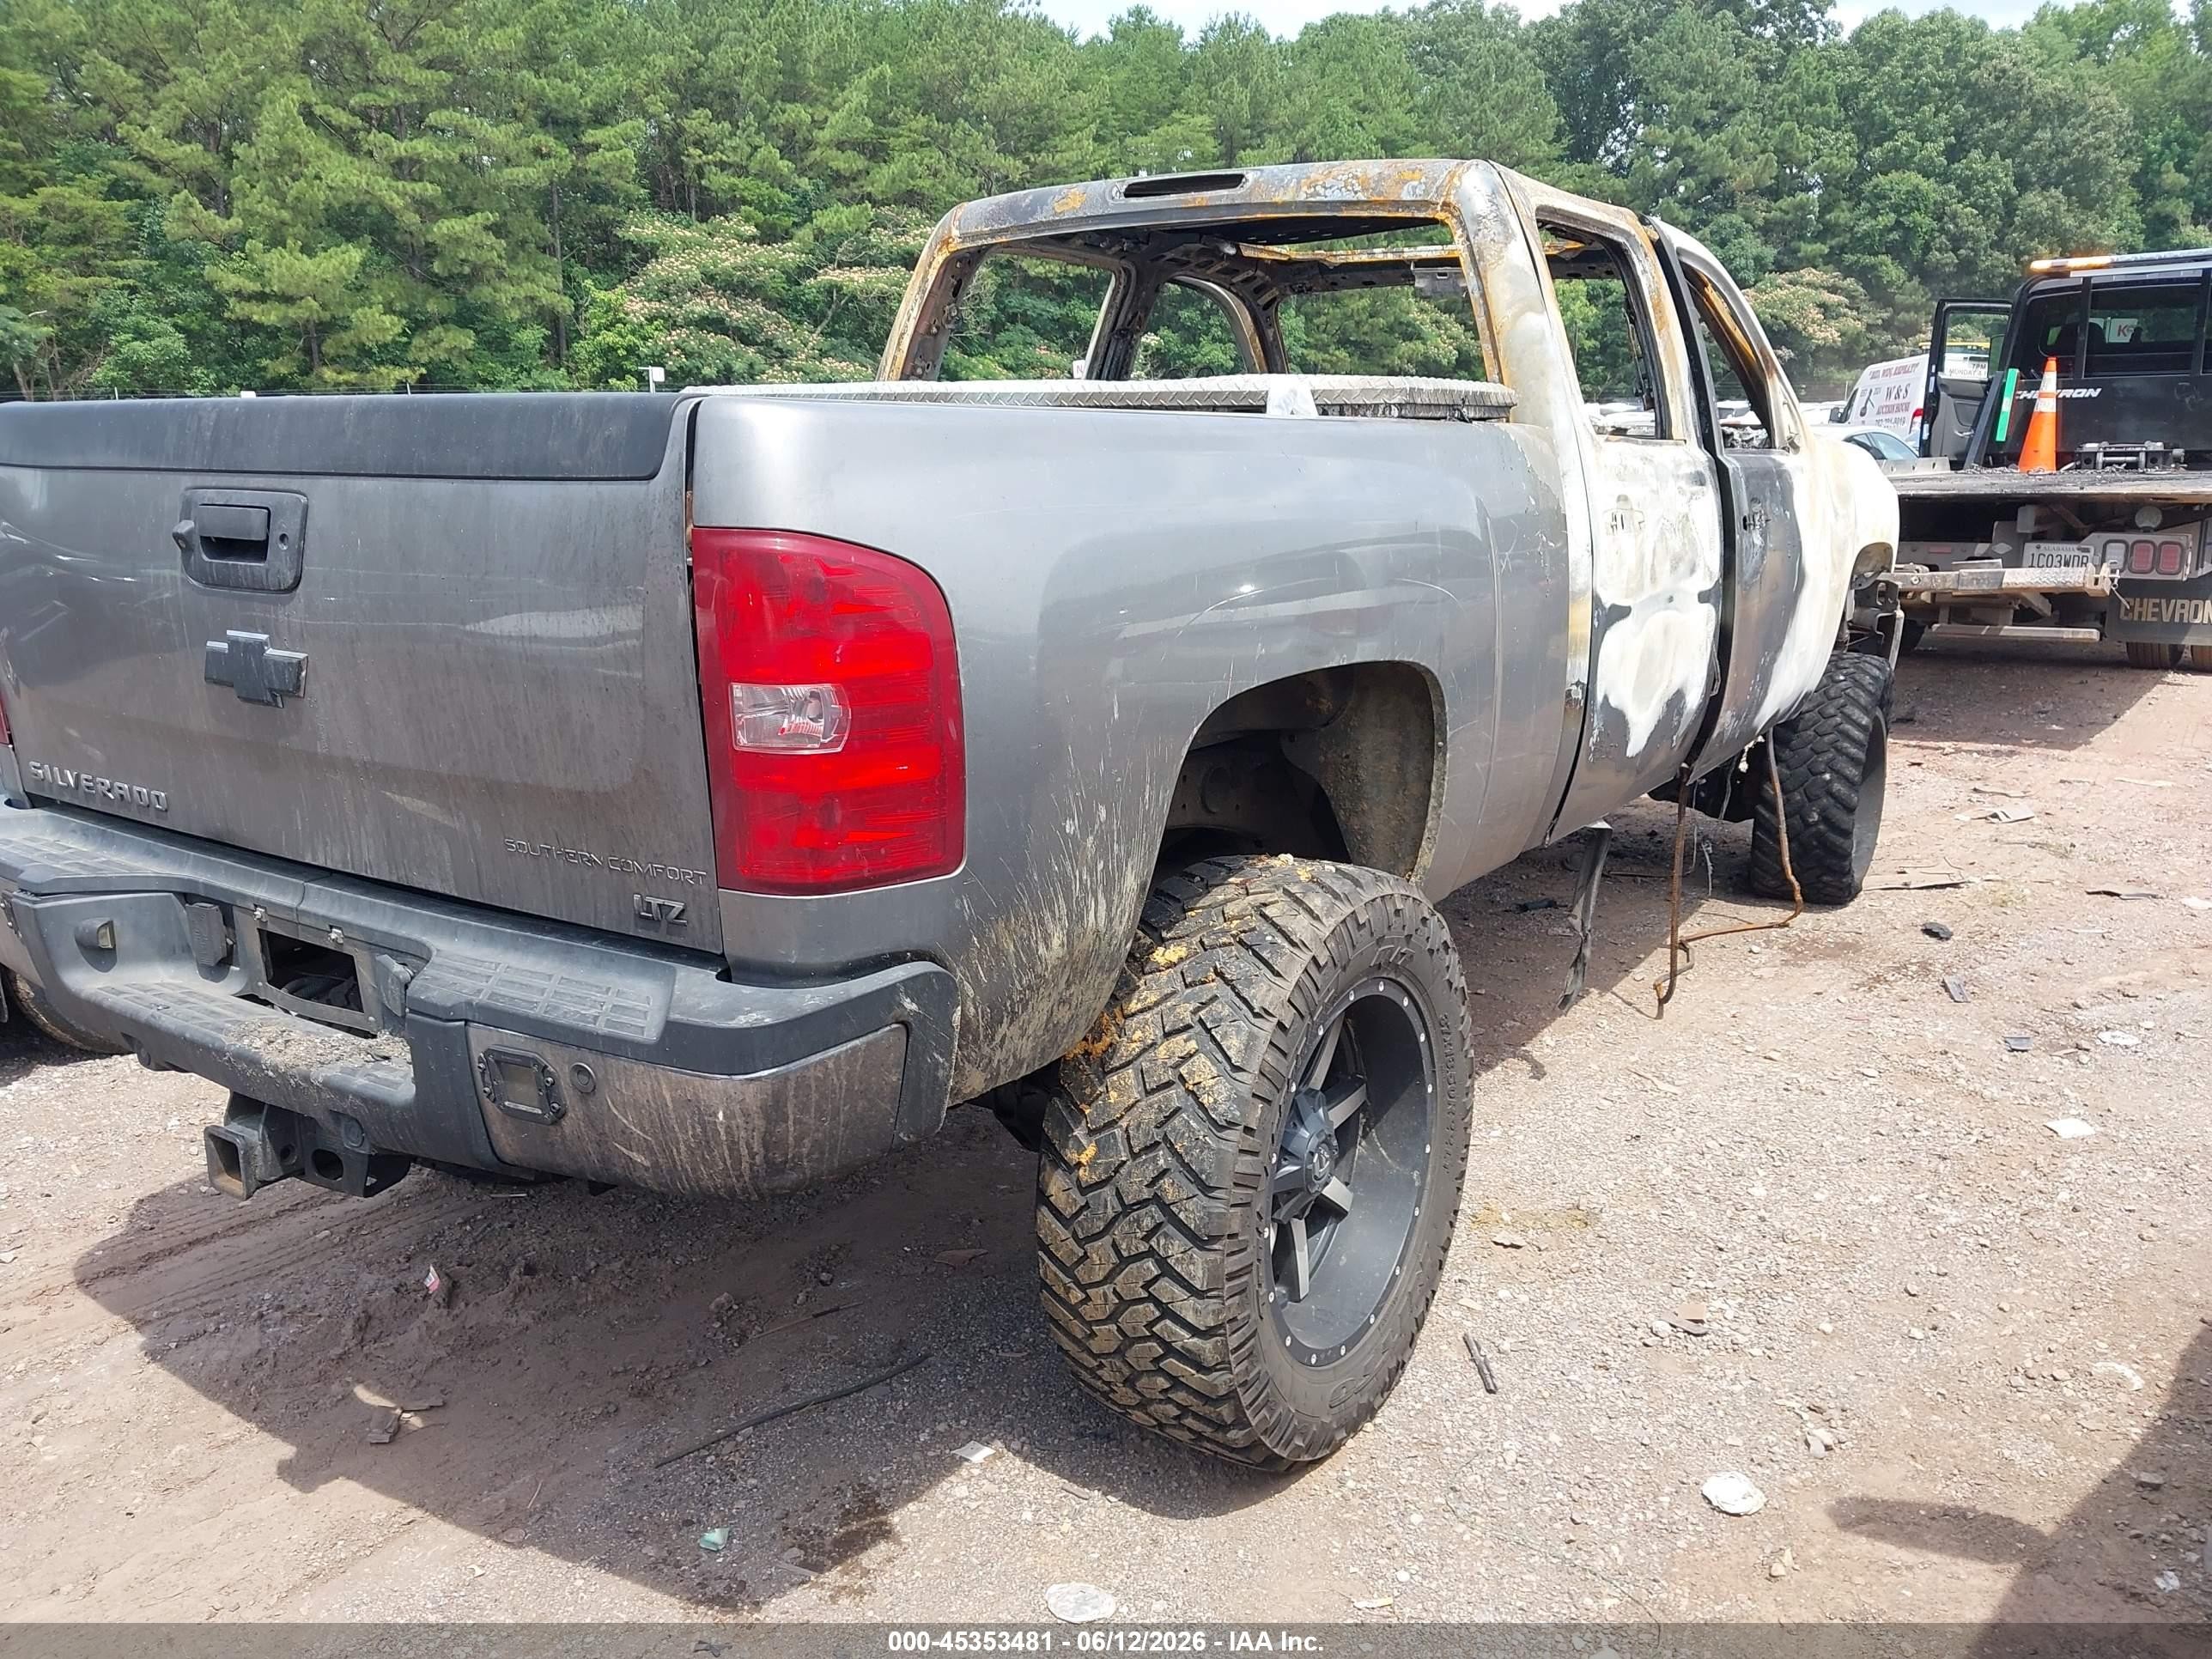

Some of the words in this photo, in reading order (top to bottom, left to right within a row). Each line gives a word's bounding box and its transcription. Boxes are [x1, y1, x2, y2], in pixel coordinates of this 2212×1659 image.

[29, 761, 168, 812] SILVERADO
[504, 838, 604, 867] SOUTHERN
[607, 855, 707, 885] COMFORT
[633, 893, 688, 926] LTZ
